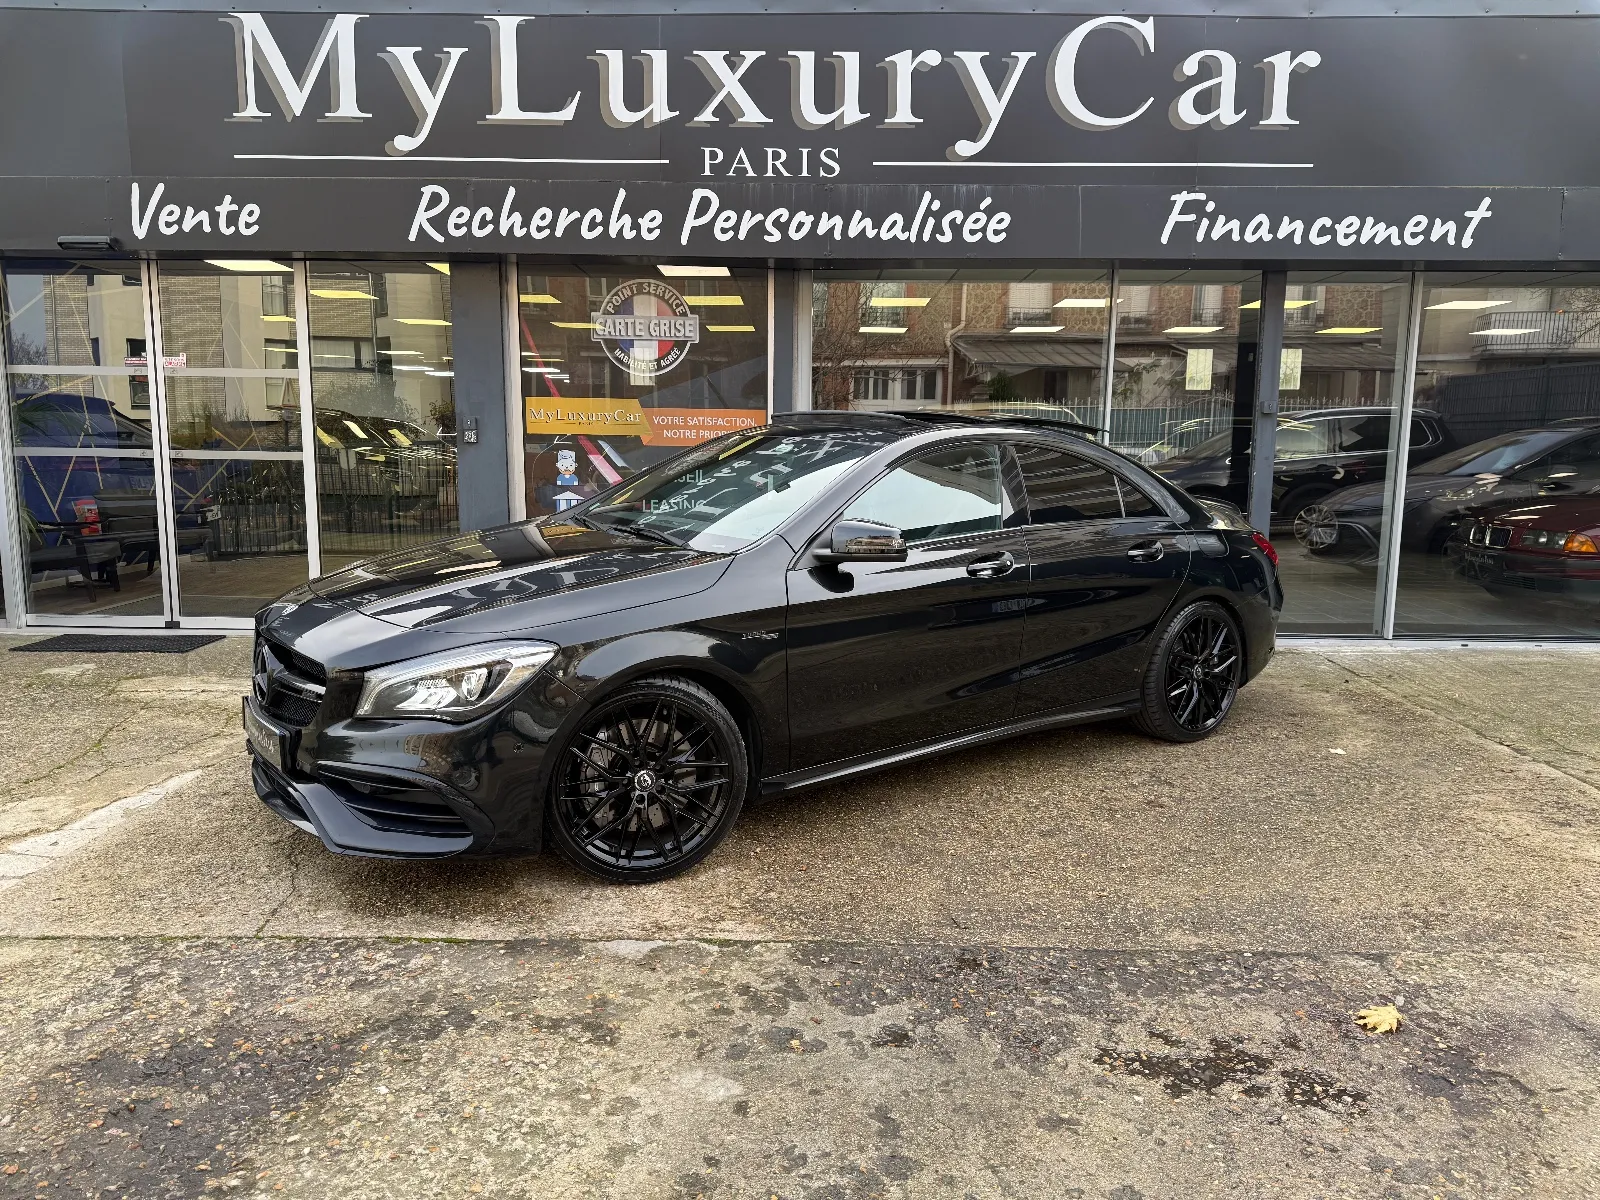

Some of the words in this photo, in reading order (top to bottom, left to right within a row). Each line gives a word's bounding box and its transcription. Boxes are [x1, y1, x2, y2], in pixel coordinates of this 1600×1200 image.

[224, 12, 1322, 156] MyLuxuryCar
[701, 146, 841, 178] PARIS
[130, 182, 262, 241] Vente
[407, 184, 663, 243] Recherche
[680, 188, 1012, 246] Personnalisée
[1160, 191, 1492, 249] Financement
[606, 284, 638, 314] POINT
[642, 282, 687, 316] SERVICE
[595, 317, 644, 337] CARTE
[650, 318, 695, 338] GRISE
[649, 361, 658, 370] ET
[529, 407, 642, 424] MyLuxuryCar
[652, 415, 685, 426] VOTRE
[663, 429, 697, 439] NOTRE
